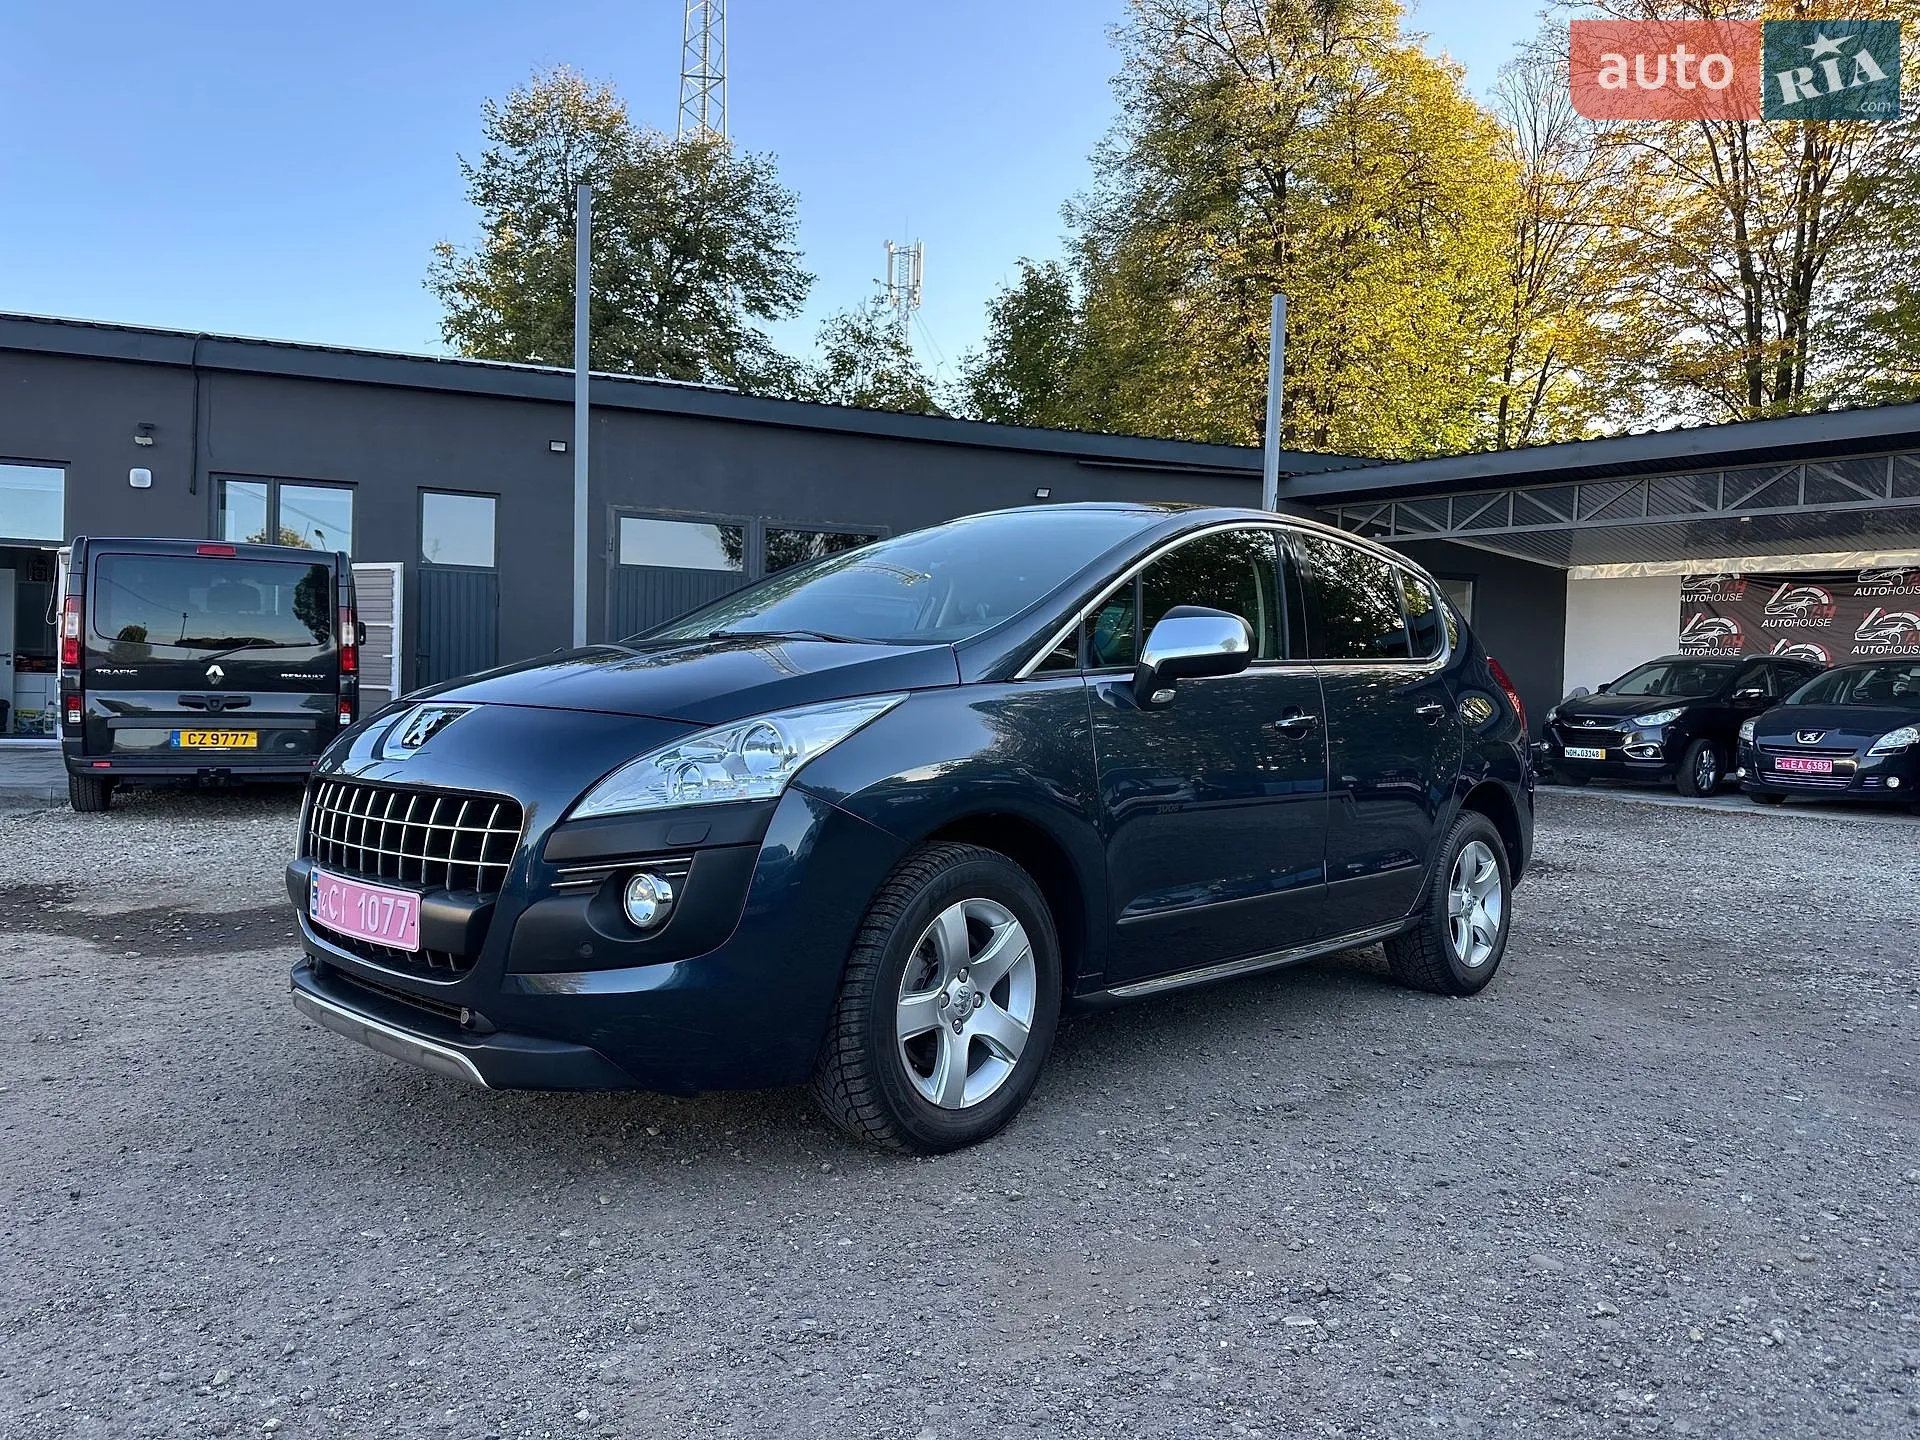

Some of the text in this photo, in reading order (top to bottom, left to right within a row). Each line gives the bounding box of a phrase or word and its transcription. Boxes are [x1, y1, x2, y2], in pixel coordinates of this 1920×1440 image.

[1853, 585, 1920, 597] AUTOHOUS
[1680, 592, 1744, 603] AUTOHOUSE
[1760, 618, 1833, 628] AUTOHOUSE
[1676, 647, 1742, 657] AUTOHOUSE
[1850, 645, 1920, 655] AUTOHOUS
[95, 668, 139, 676] TRAFIC
[187, 733, 207, 745] CZ
[210, 733, 249, 746] 9777
[1806, 761, 1829, 771] 6389
[357, 892, 411, 939] 1077
